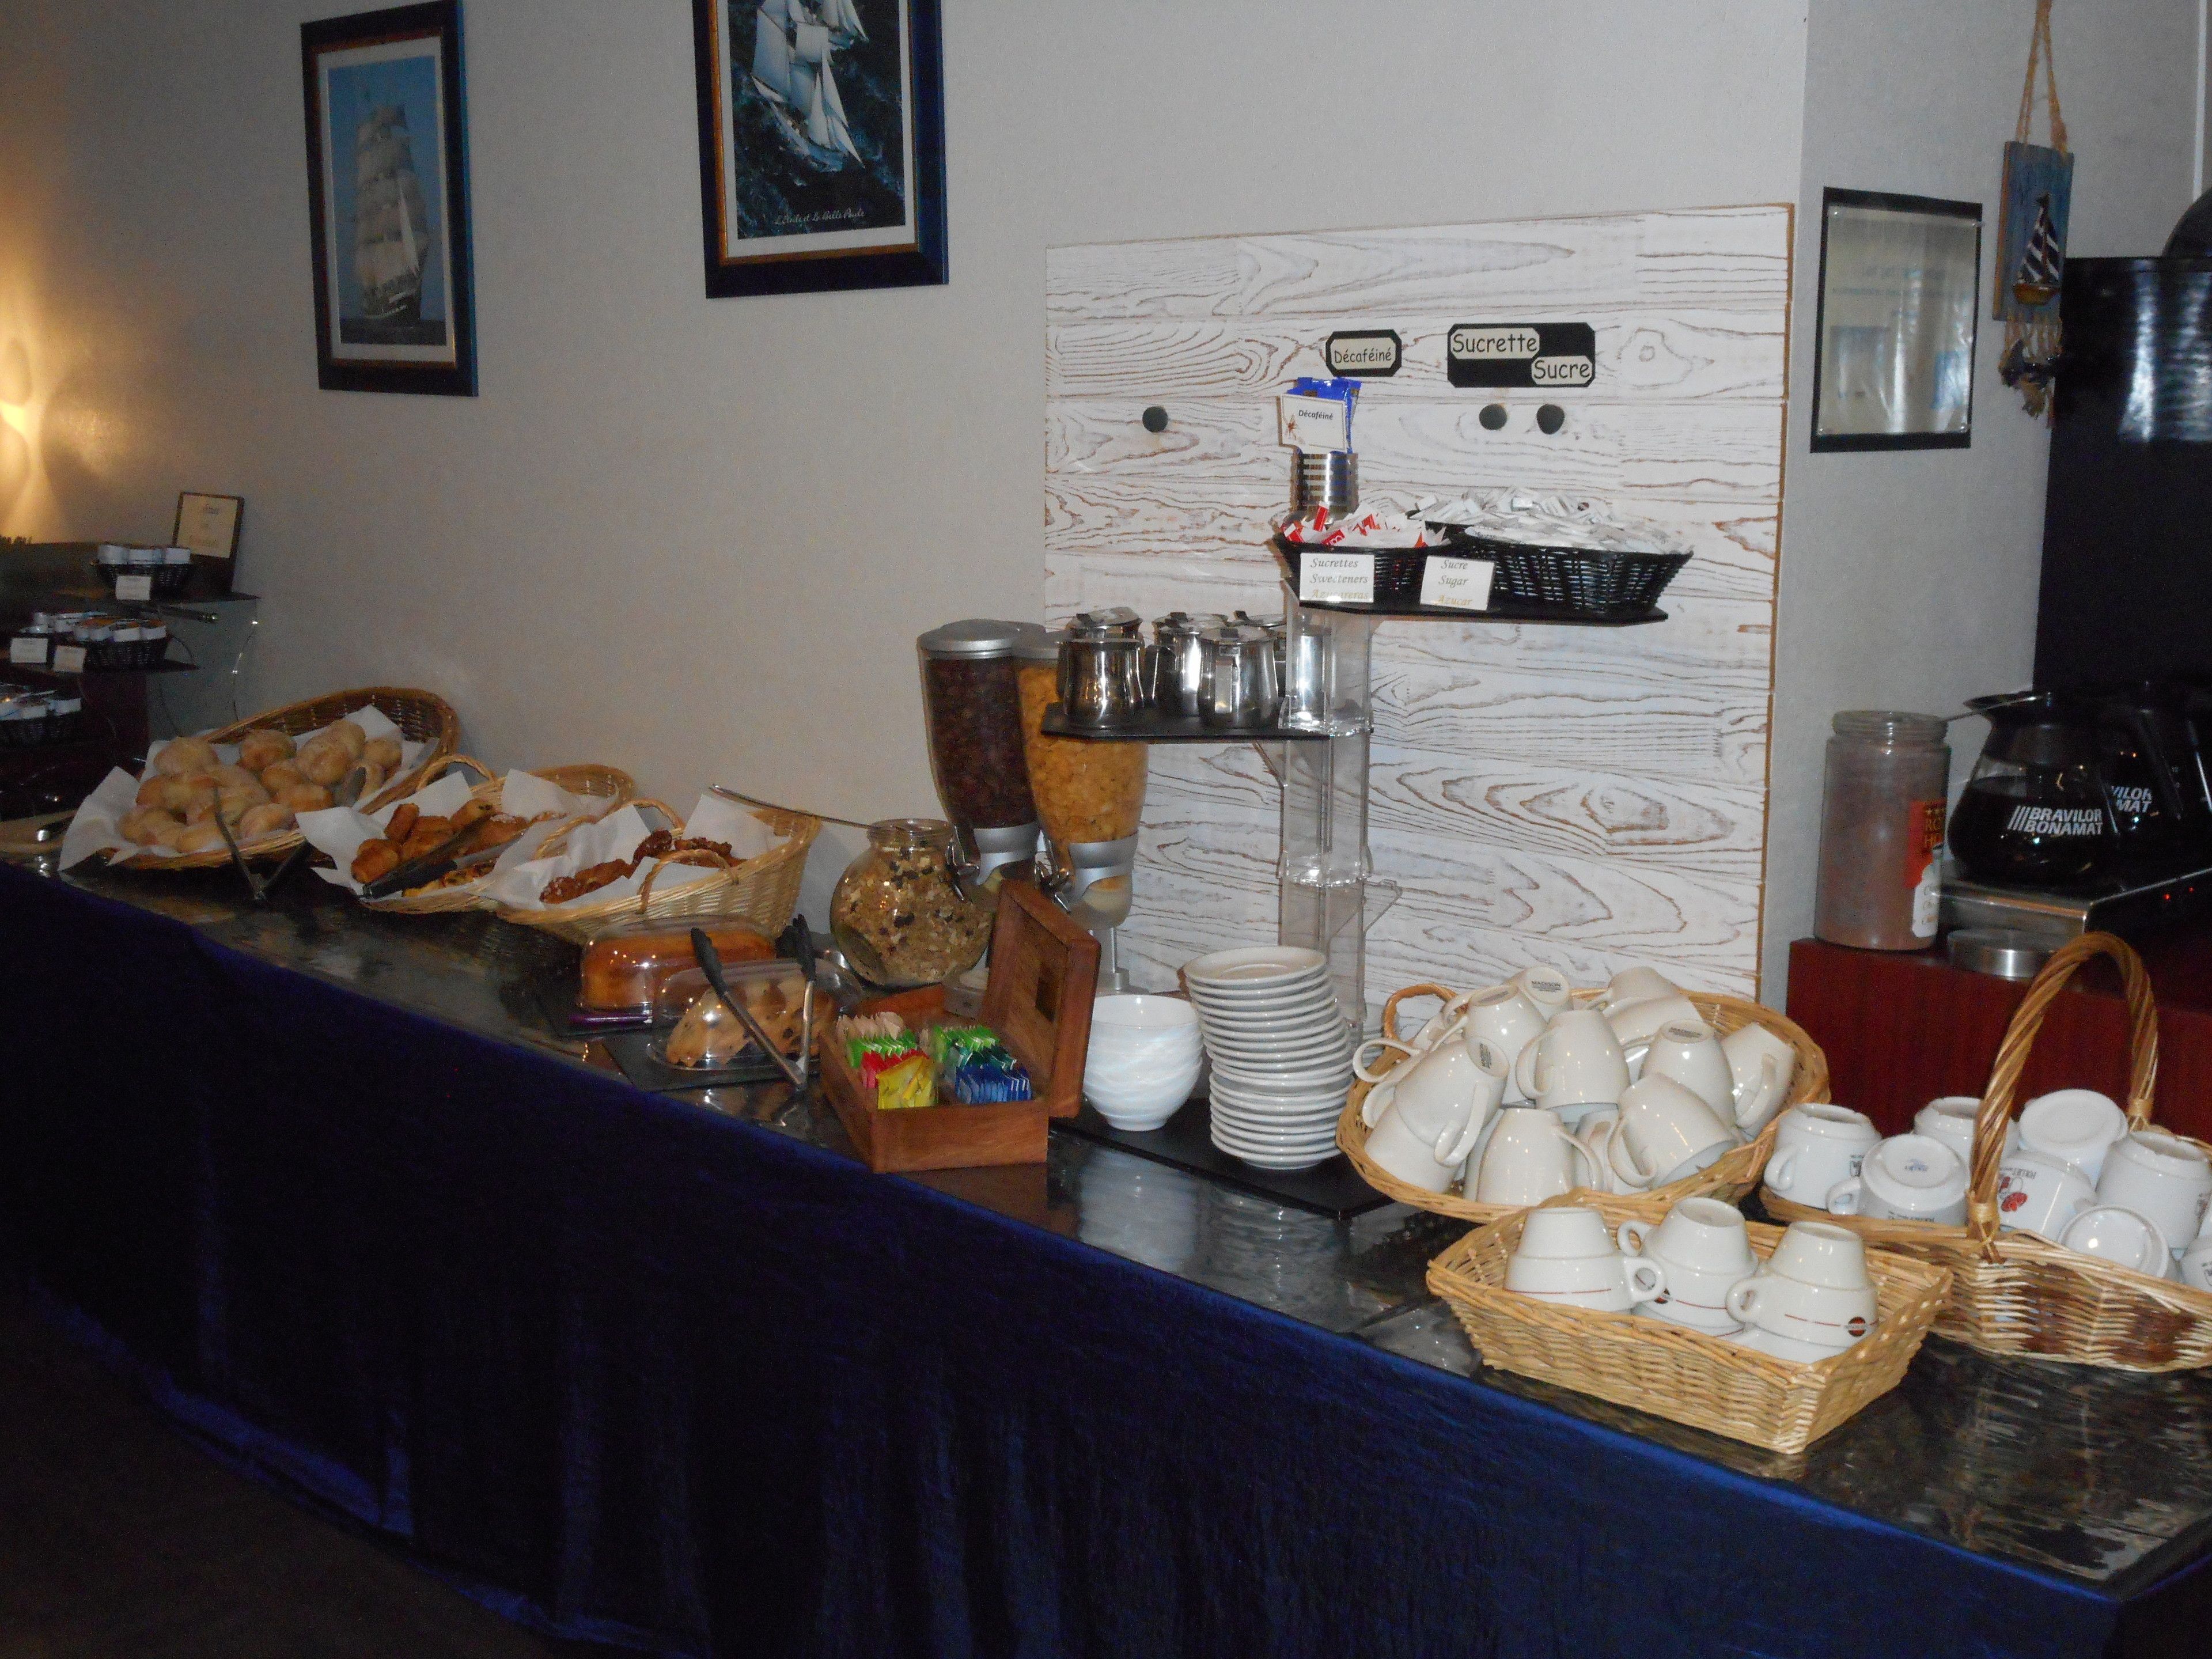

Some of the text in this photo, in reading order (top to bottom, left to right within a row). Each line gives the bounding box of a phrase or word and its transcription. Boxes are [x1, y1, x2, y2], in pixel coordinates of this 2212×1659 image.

[1452, 334, 1538, 354] Sucrette
[1334, 348, 1392, 364] Décaféiné
[1533, 359, 1591, 380] Sucre
[1298, 410, 1334, 421] Décaféiné
[1310, 557, 1359, 568] Sucrettes
[1441, 559, 1468, 570] Sucre
[1438, 574, 1468, 588] Sugar
[2028, 806, 2103, 822] BRAVILOR
[2024, 819, 2103, 835] BONAMAT
